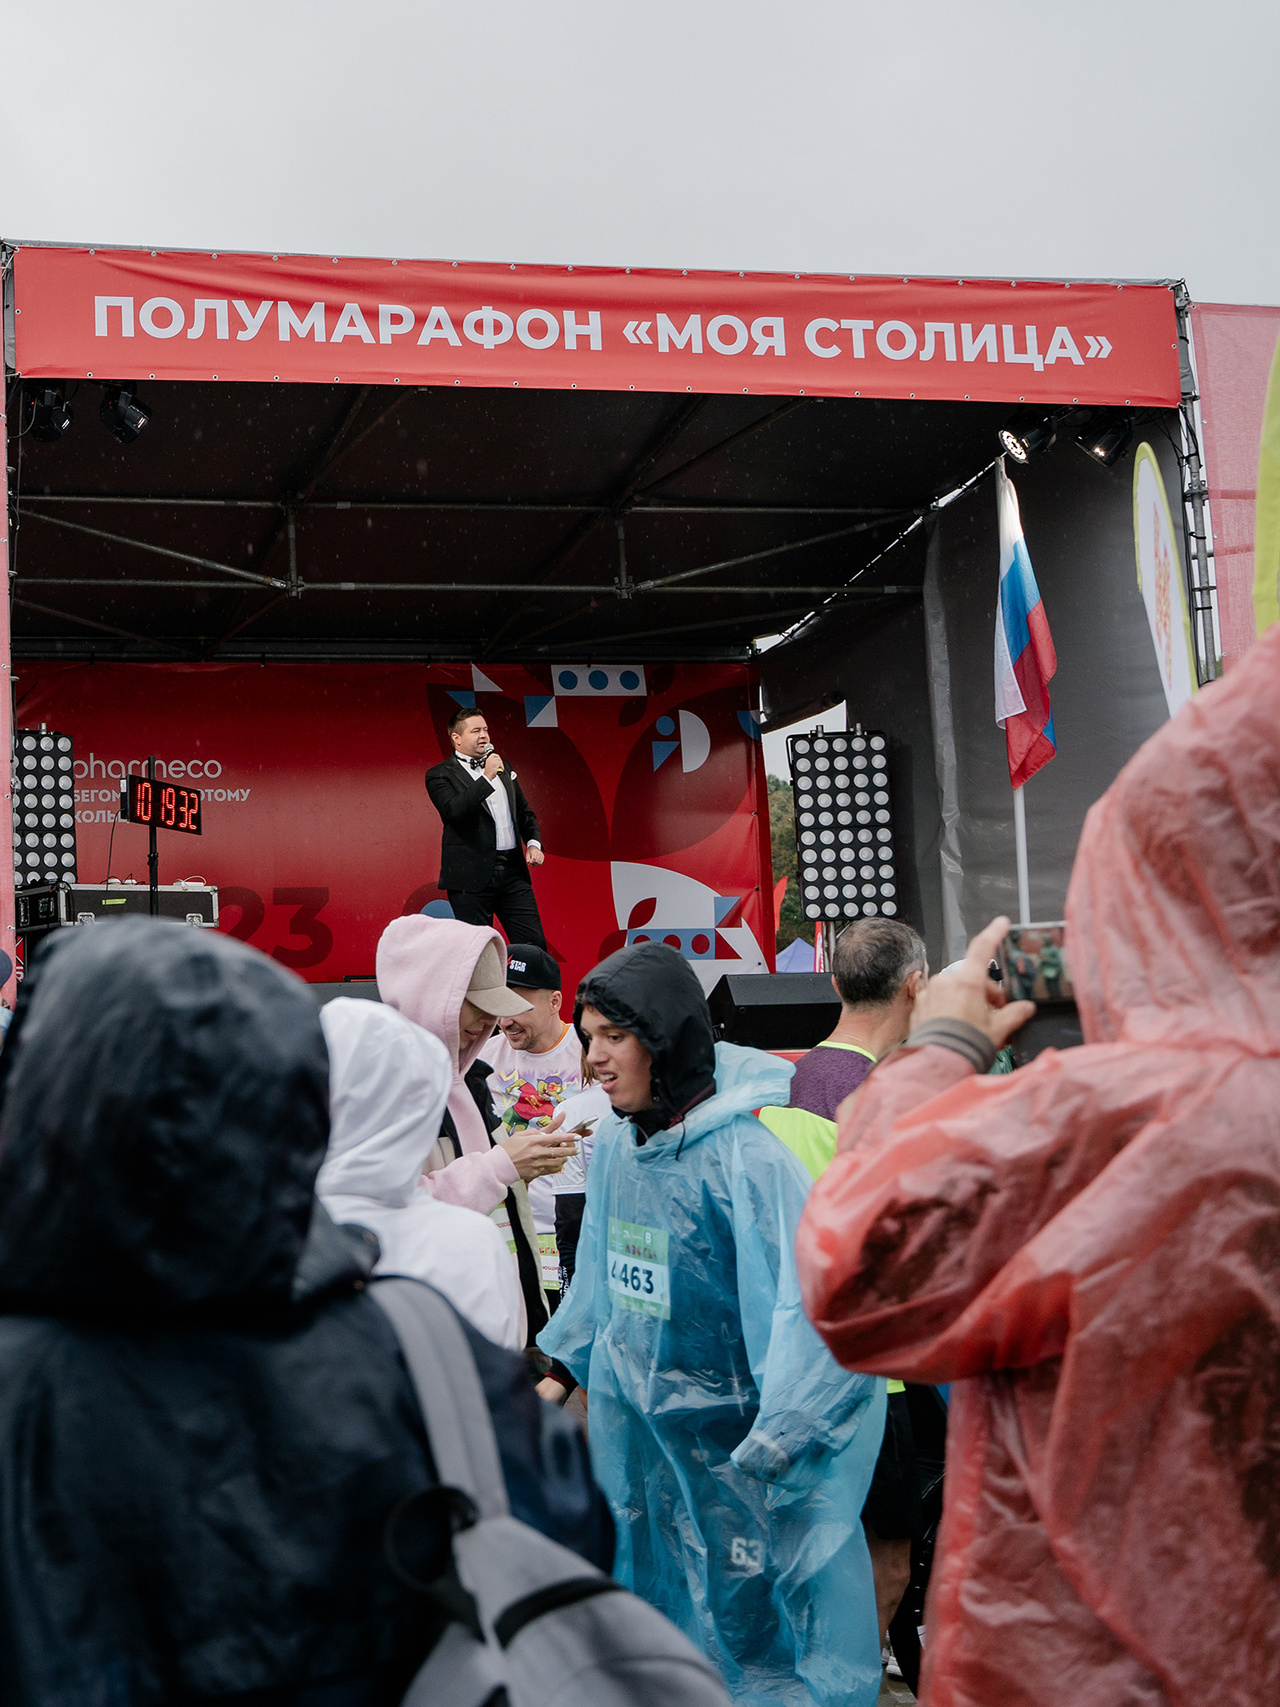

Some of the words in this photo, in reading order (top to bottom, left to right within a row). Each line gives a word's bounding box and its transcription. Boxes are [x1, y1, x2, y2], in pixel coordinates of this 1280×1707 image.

[94, 295, 603, 350] ПОЛУМАРАФОН
[622, 312, 786, 357] «МОЯ
[803, 317, 1113, 372] СТОЛИЦА»
